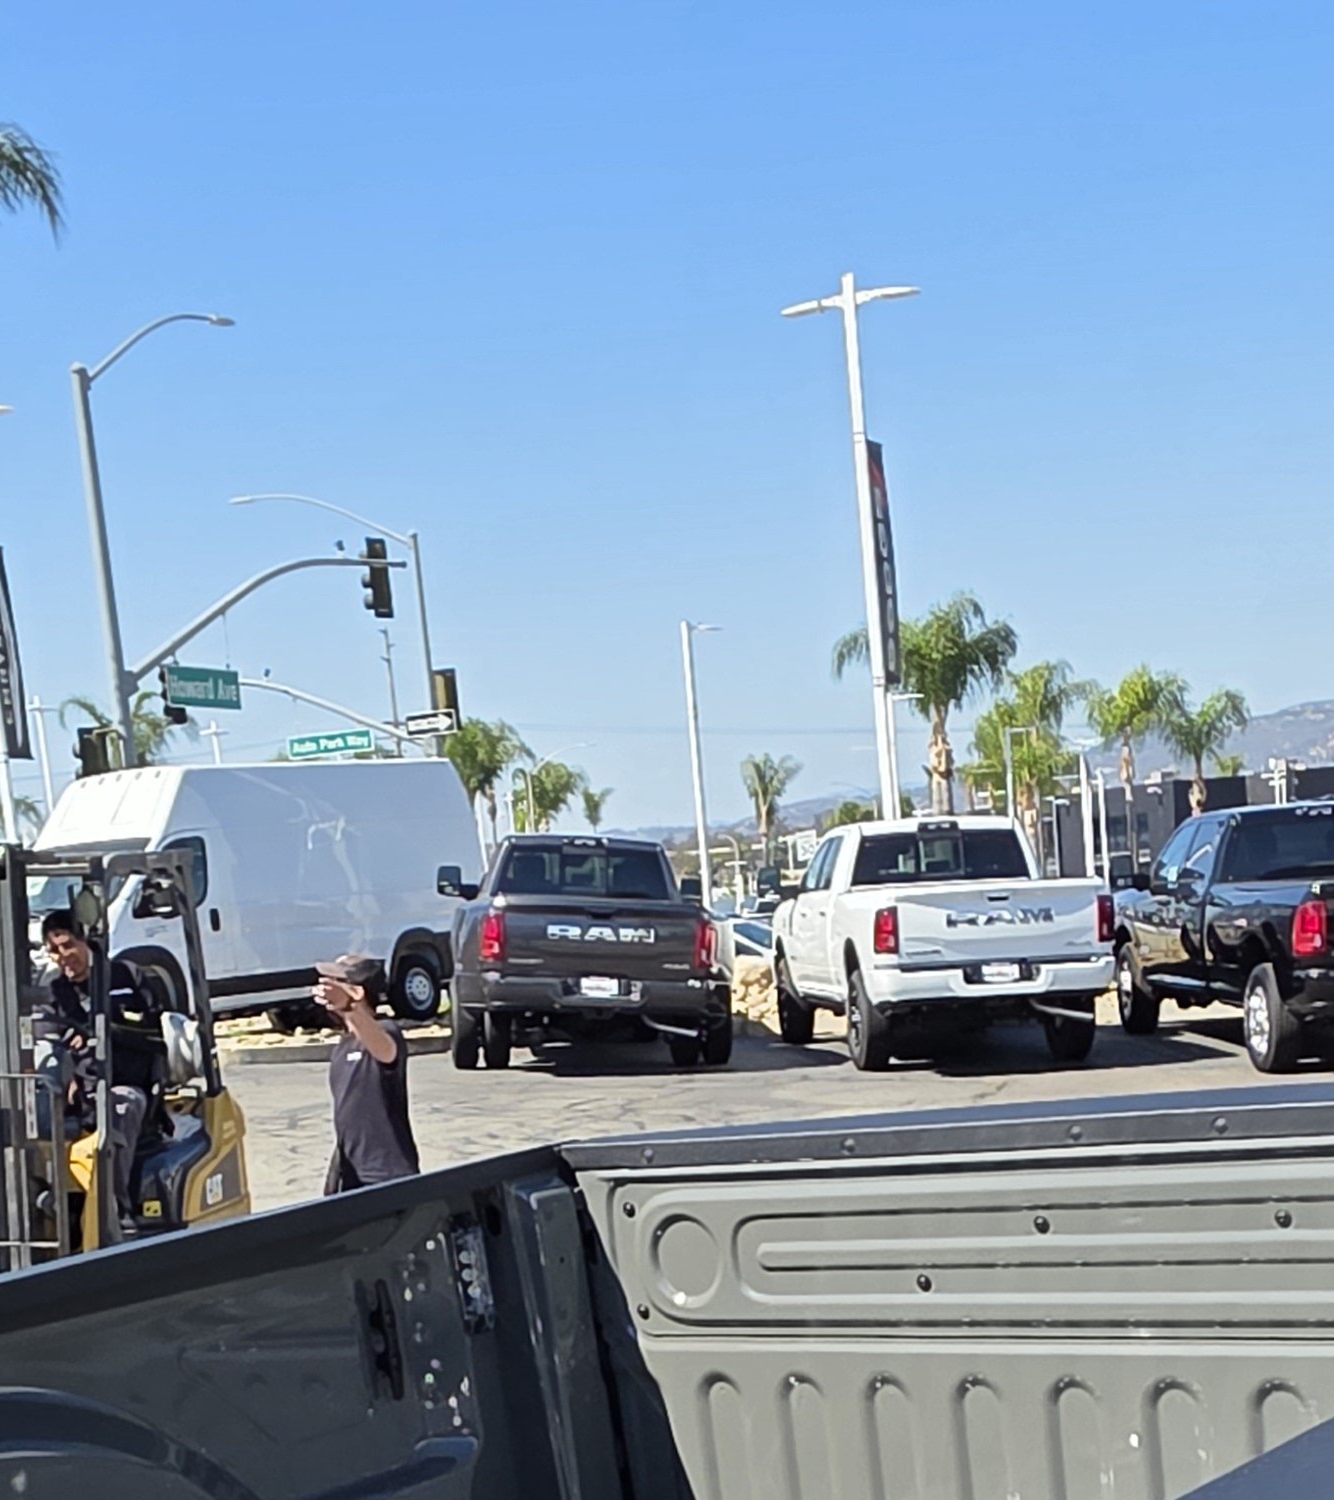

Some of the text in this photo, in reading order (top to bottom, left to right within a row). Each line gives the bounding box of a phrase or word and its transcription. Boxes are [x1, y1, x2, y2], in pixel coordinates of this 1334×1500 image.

[170, 674, 238, 701] Howard Ave
[292, 734, 369, 754] Auto Park Way
[945, 907, 1055, 929] RAM
[546, 924, 655, 944] RAM
